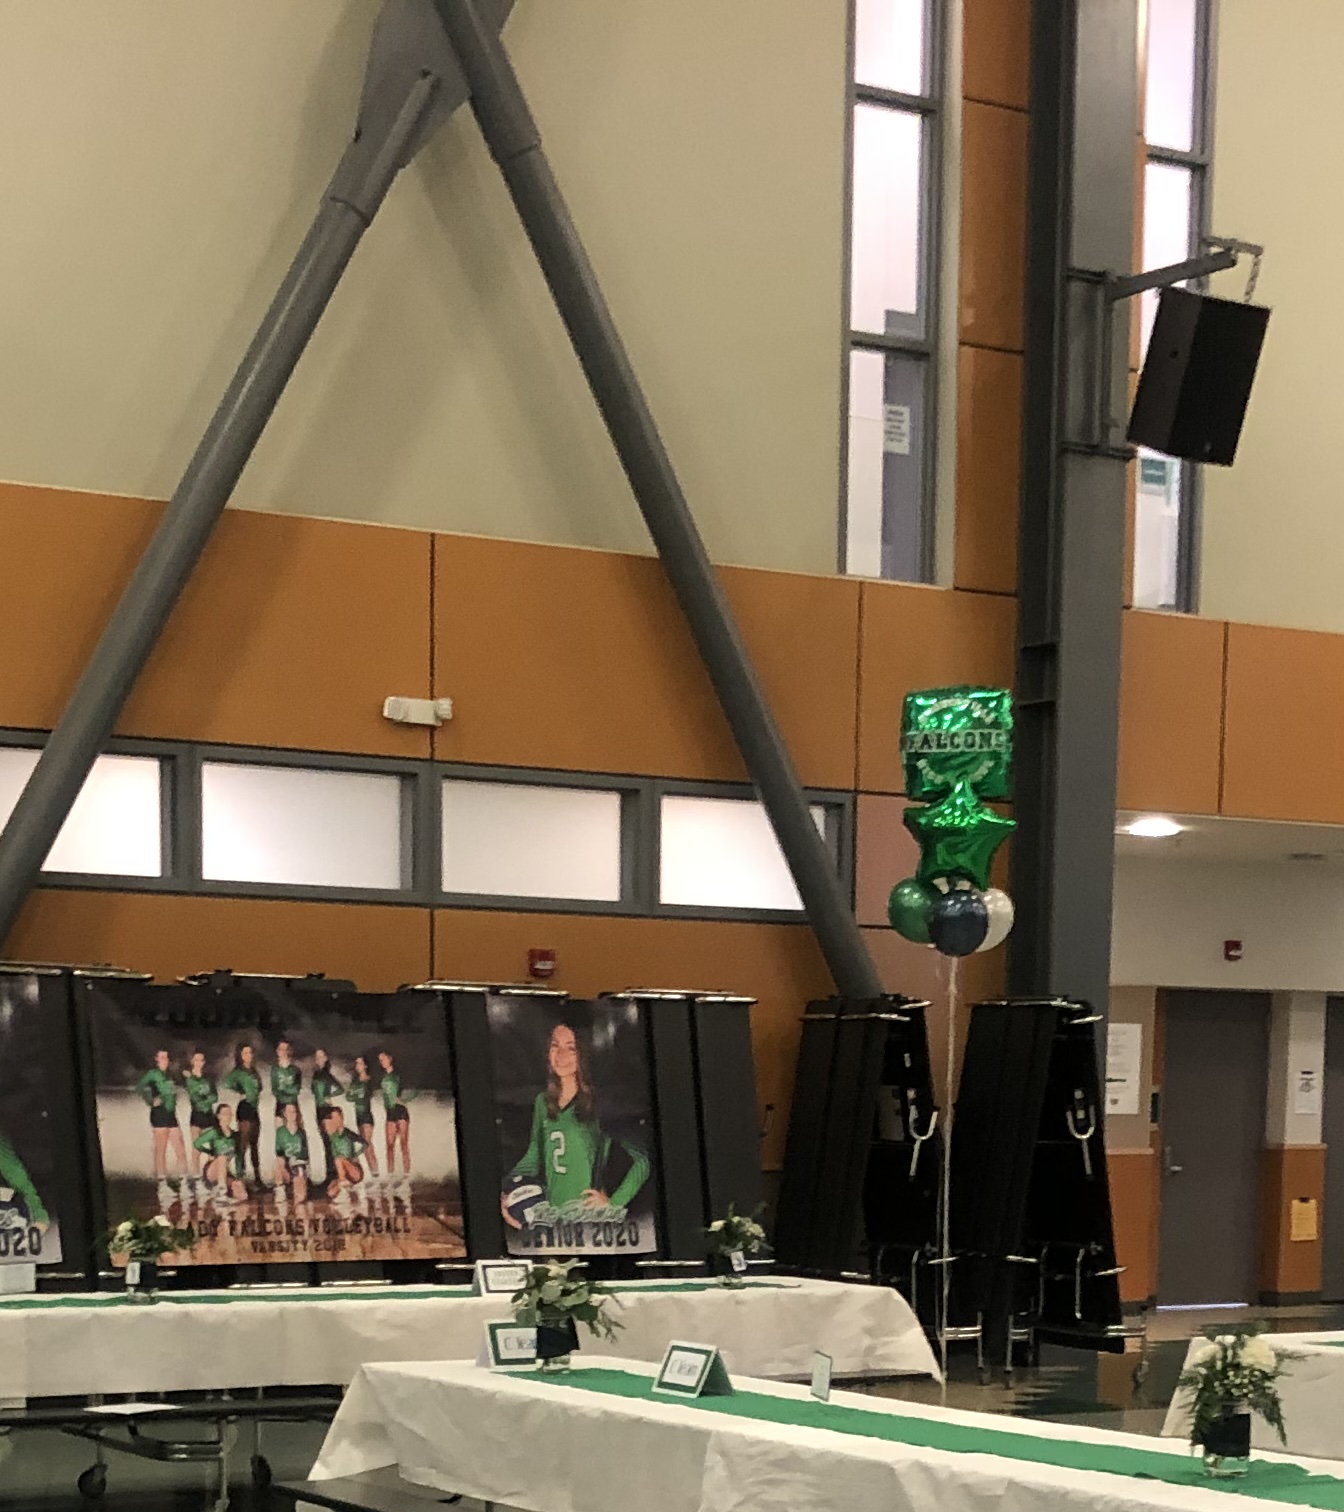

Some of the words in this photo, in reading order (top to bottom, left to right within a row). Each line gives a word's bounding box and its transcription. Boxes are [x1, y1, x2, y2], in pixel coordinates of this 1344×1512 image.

[905, 731, 1011, 752] FALCONS
[550, 1130, 567, 1174] 2
[229, 1217, 305, 1237] FALCONS
[311, 1215, 411, 1236] VOLLEYBALL
[592, 1222, 639, 1247] 2020
[251, 1239, 308, 1253] VARSITY
